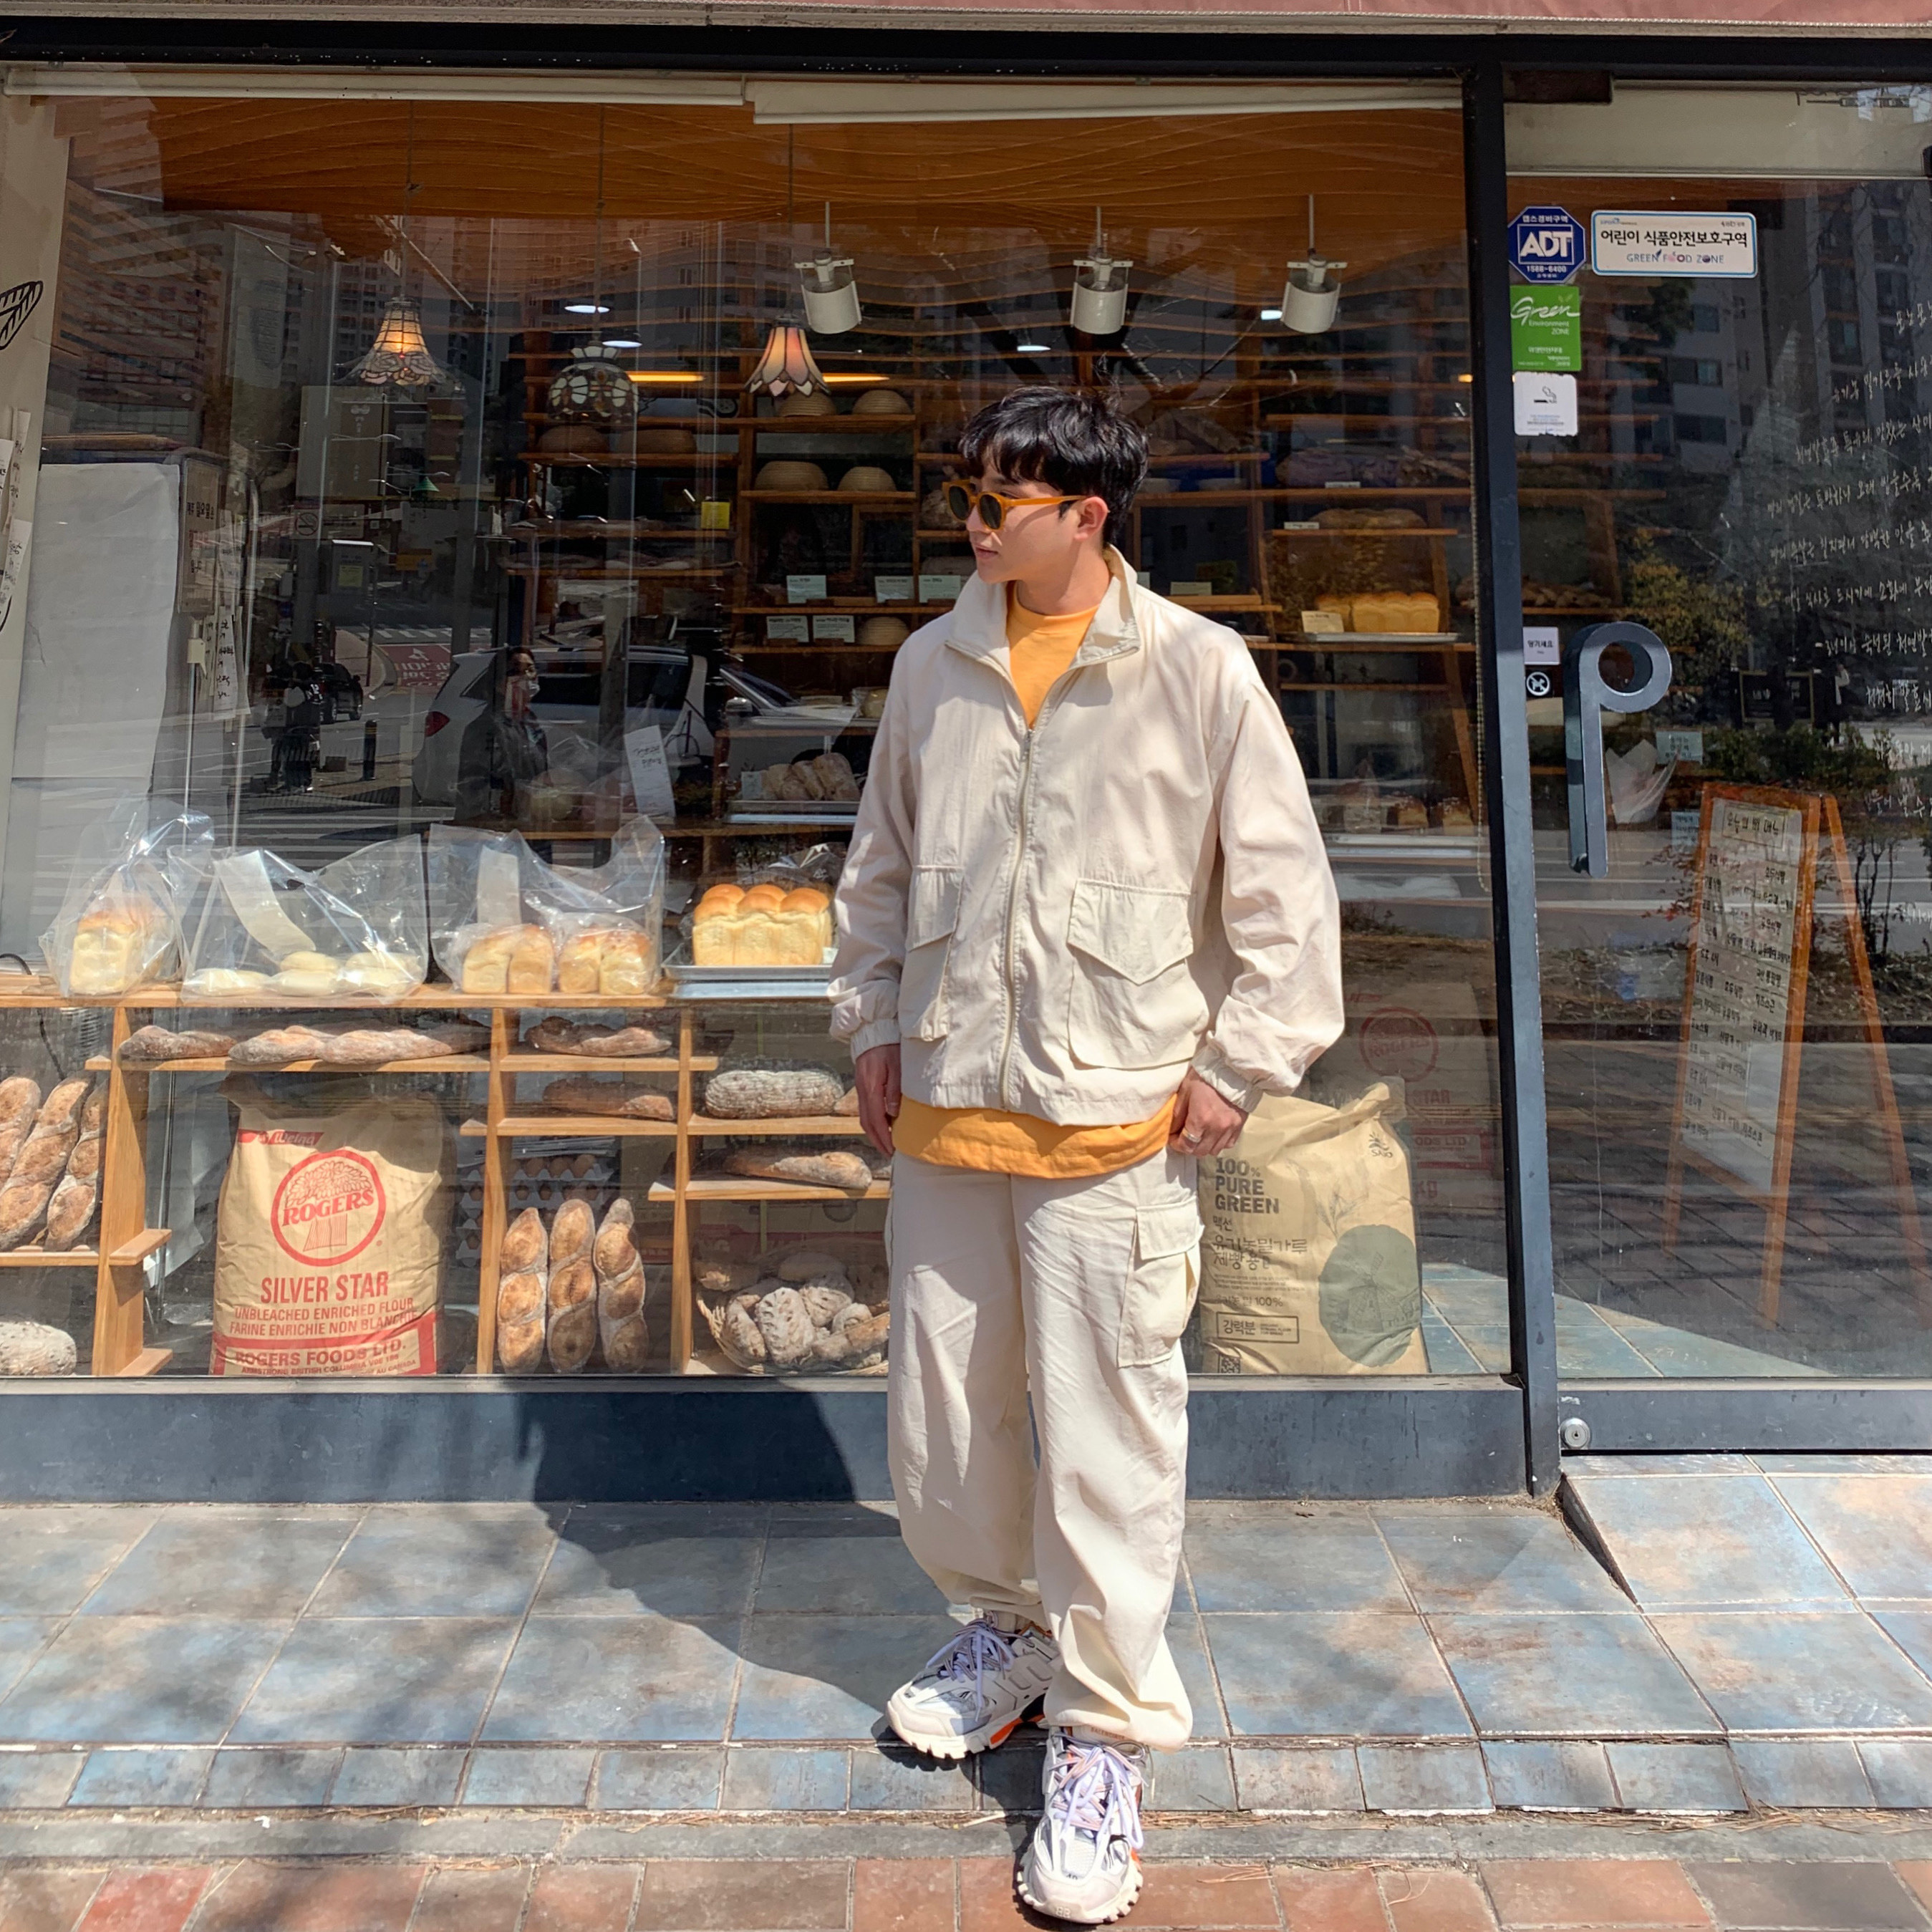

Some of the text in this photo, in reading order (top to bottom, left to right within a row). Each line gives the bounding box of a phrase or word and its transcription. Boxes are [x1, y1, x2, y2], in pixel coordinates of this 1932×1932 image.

[1520, 231, 1573, 257] ADT
[1600, 230, 1747, 248] 어린이 식품안전보호구역
[1626, 252, 1724, 264] GREEN FOOD ZONE
[1510, 296, 1581, 326] Green
[1727, 812, 1749, 834] 오늘의
[1216, 1157, 1260, 1177] 100%
[1215, 1175, 1265, 1195] PURE
[281, 1189, 375, 1227] ROGERS
[1214, 1194, 1280, 1214] GREEN
[1214, 1235, 1308, 1254] 유기농밀가루
[260, 1270, 390, 1304] SILVER STAR
[235, 1297, 414, 1321] UNBLEACHED ENRICHED FLOUR
[1255, 1296, 1284, 1308] 100%
[229, 1321, 266, 1336] FARINE
[269, 1318, 326, 1336] ENRICHIE
[329, 1319, 358, 1335] NON
[1223, 1320, 1256, 1336] 강력분
[235, 1338, 407, 1366] ROGERS FOODS LTD.
